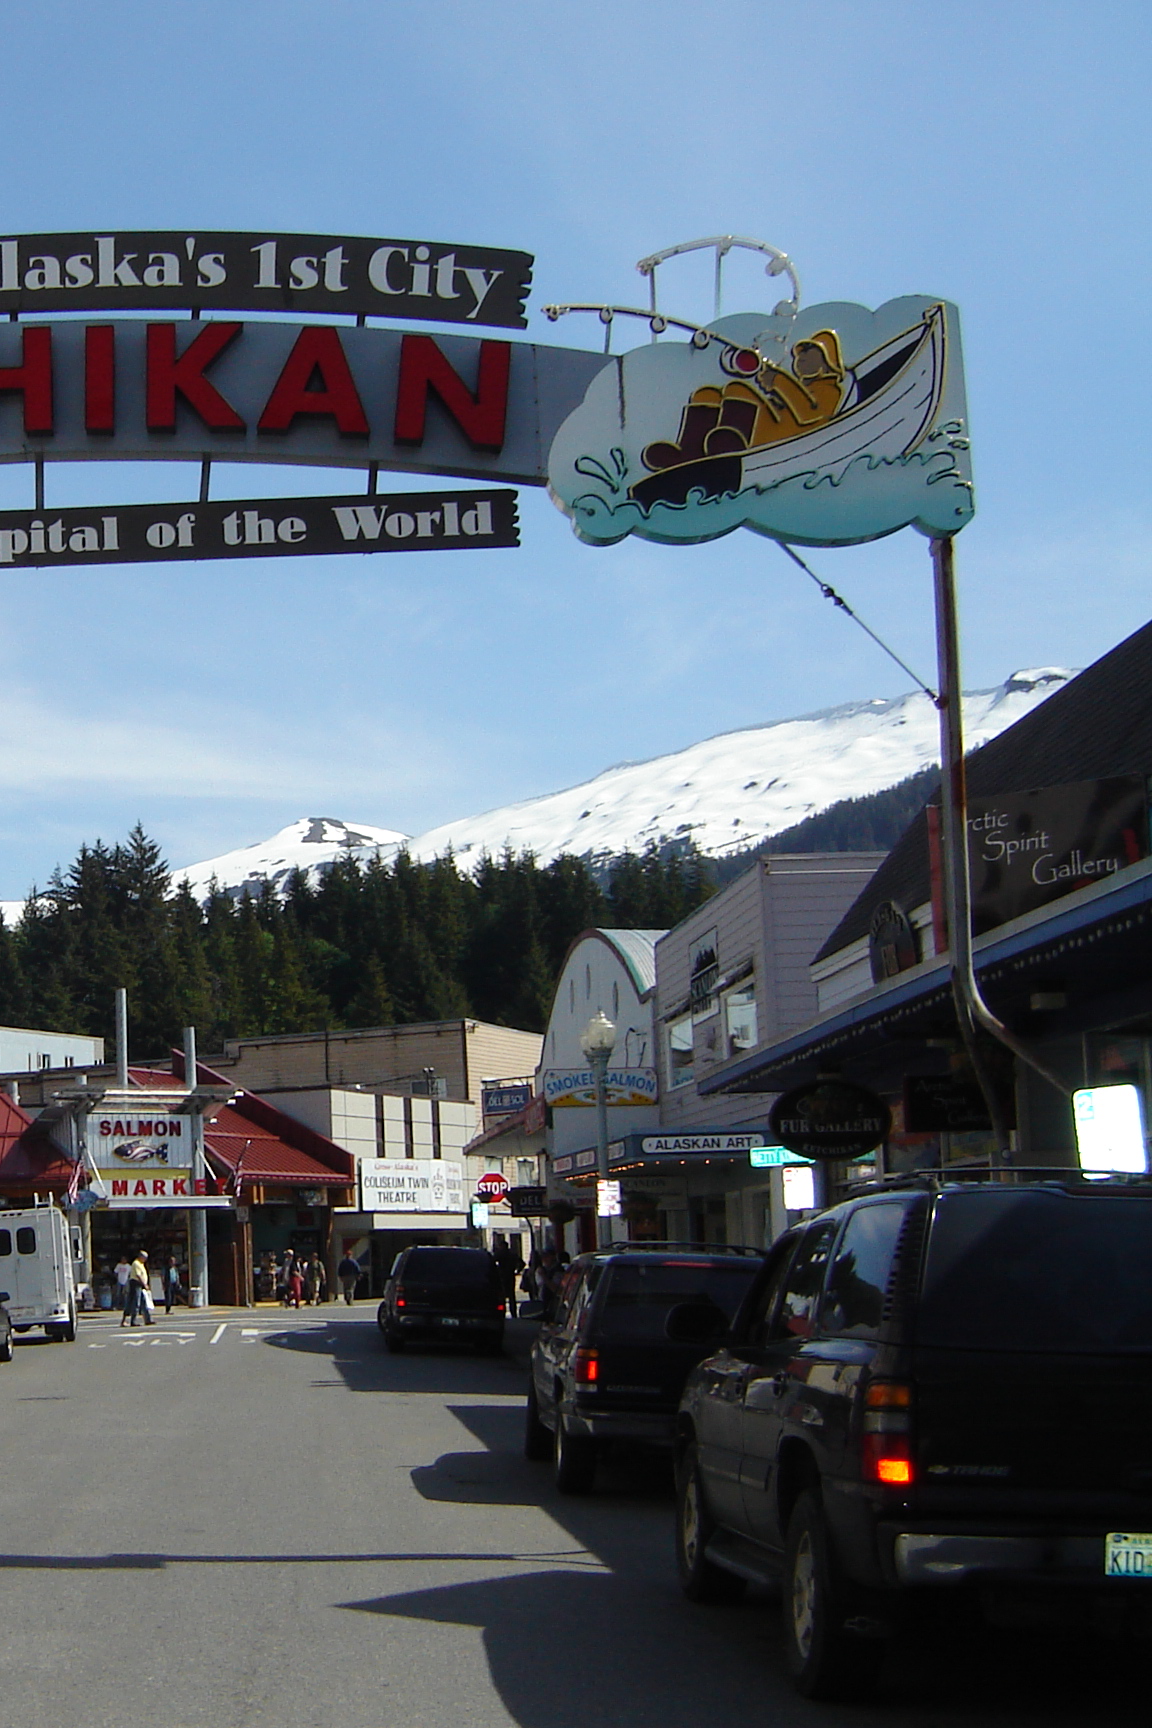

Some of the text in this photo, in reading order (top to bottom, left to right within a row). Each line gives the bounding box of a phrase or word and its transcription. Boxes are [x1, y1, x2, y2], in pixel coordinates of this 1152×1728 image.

[250, 241, 349, 292] 1st
[368, 245, 504, 318] City
[146, 513, 196, 548] of
[222, 510, 307, 546] the
[332, 501, 495, 541] World
[966, 809, 1009, 831] rctic
[981, 830, 1049, 865] Spirit
[1032, 850, 1119, 885] Gallery
[99, 1120, 182, 1137] SALMON
[779, 1117, 882, 1134] FUR GALLERY
[655, 1137, 752, 1150] ALASKAN ART
[111, 1177, 228, 1196] MARKET
[364, 1176, 429, 1189] COLISEUM TWIN
[478, 1182, 507, 1195] STOP
[377, 1191, 417, 1204] THEATRE
[1111, 1550, 1145, 1574] KID
